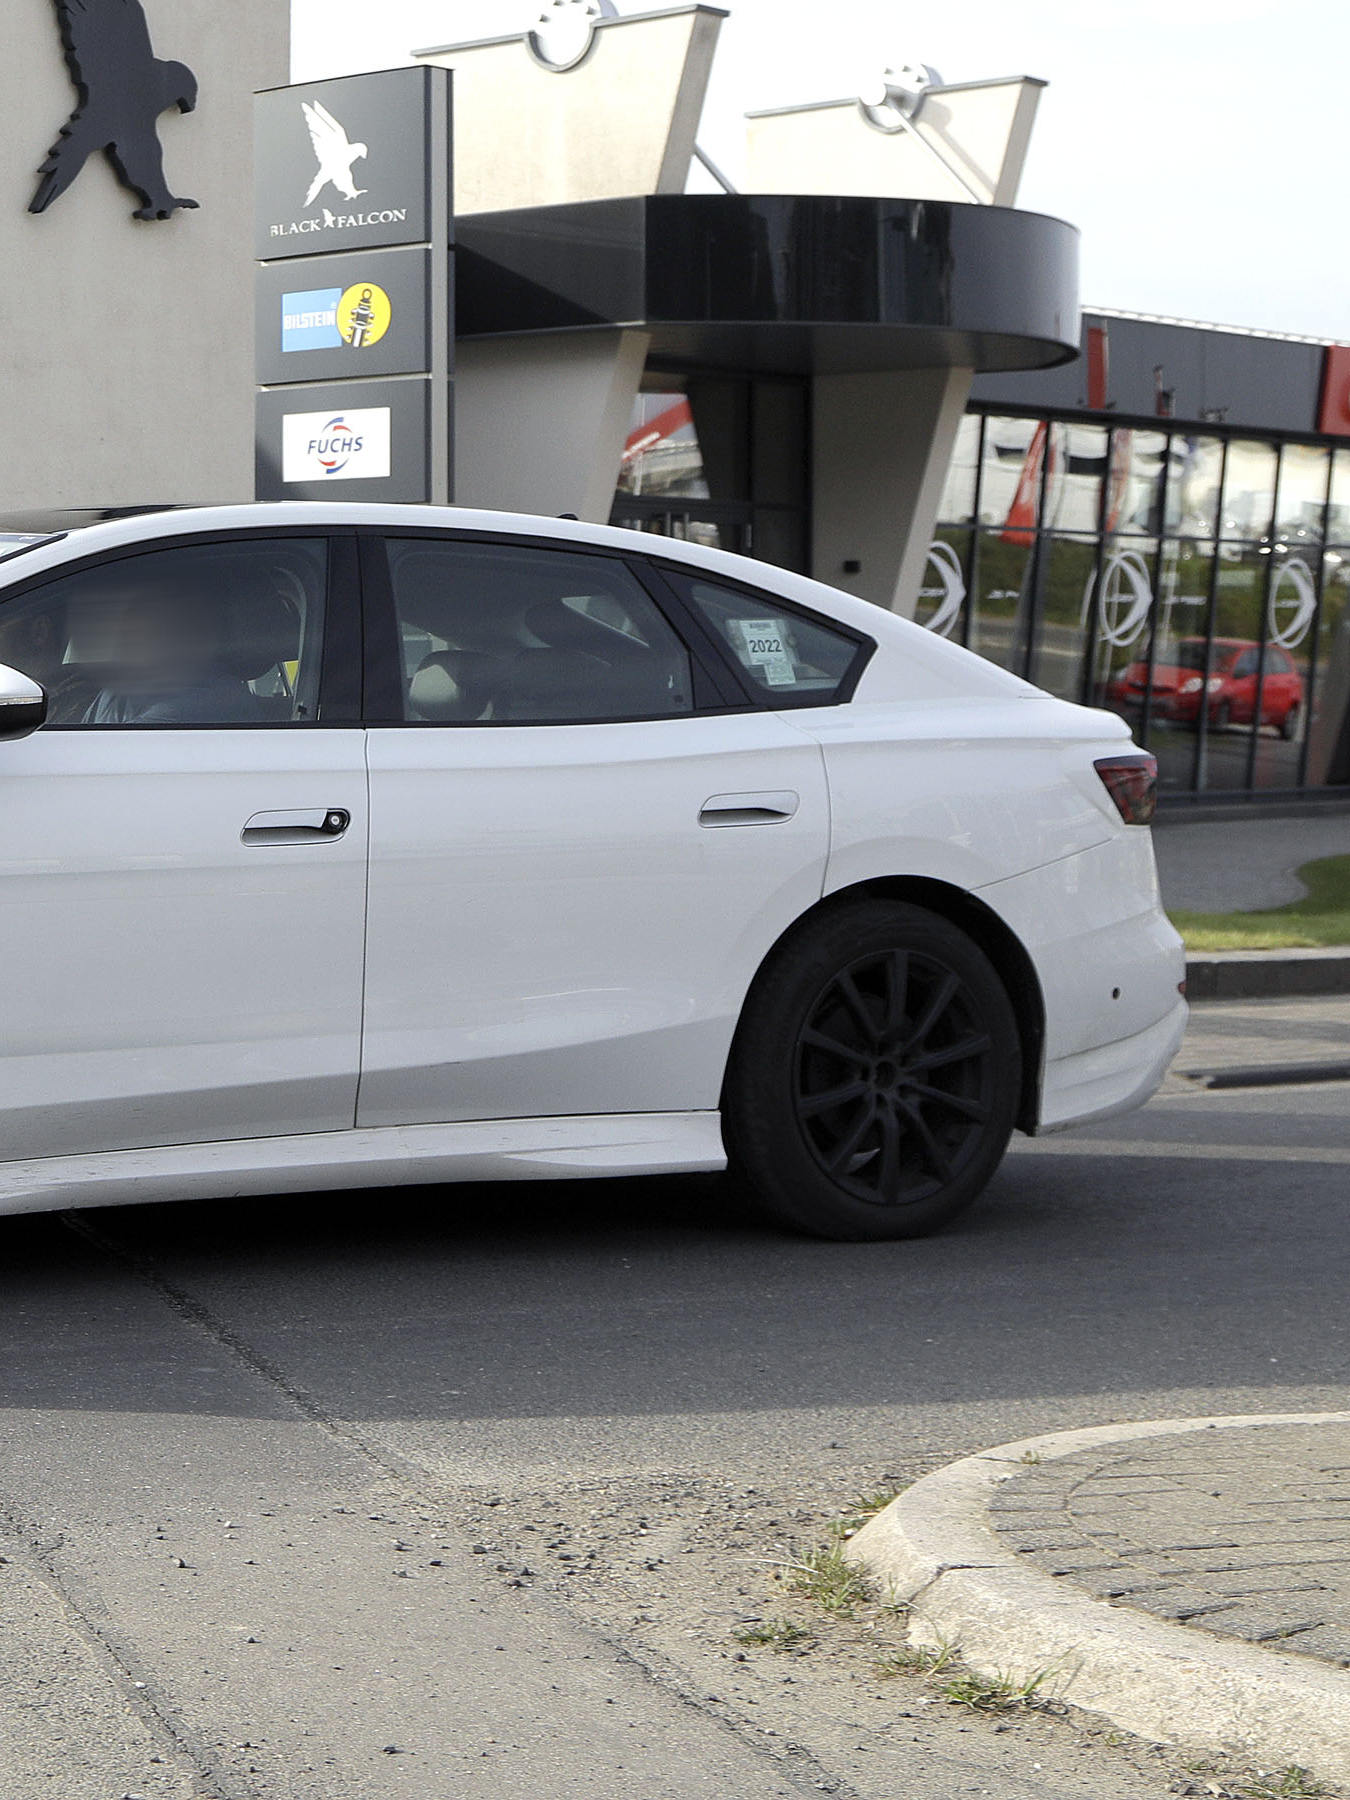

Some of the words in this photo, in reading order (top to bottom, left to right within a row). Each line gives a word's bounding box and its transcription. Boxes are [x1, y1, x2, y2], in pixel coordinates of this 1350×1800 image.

[270, 219, 321, 237] BLACK
[337, 209, 407, 229] FALCON
[284, 310, 336, 330] BILSTEIN
[307, 436, 363, 454] FUCHS
[749, 639, 782, 653] 2022
